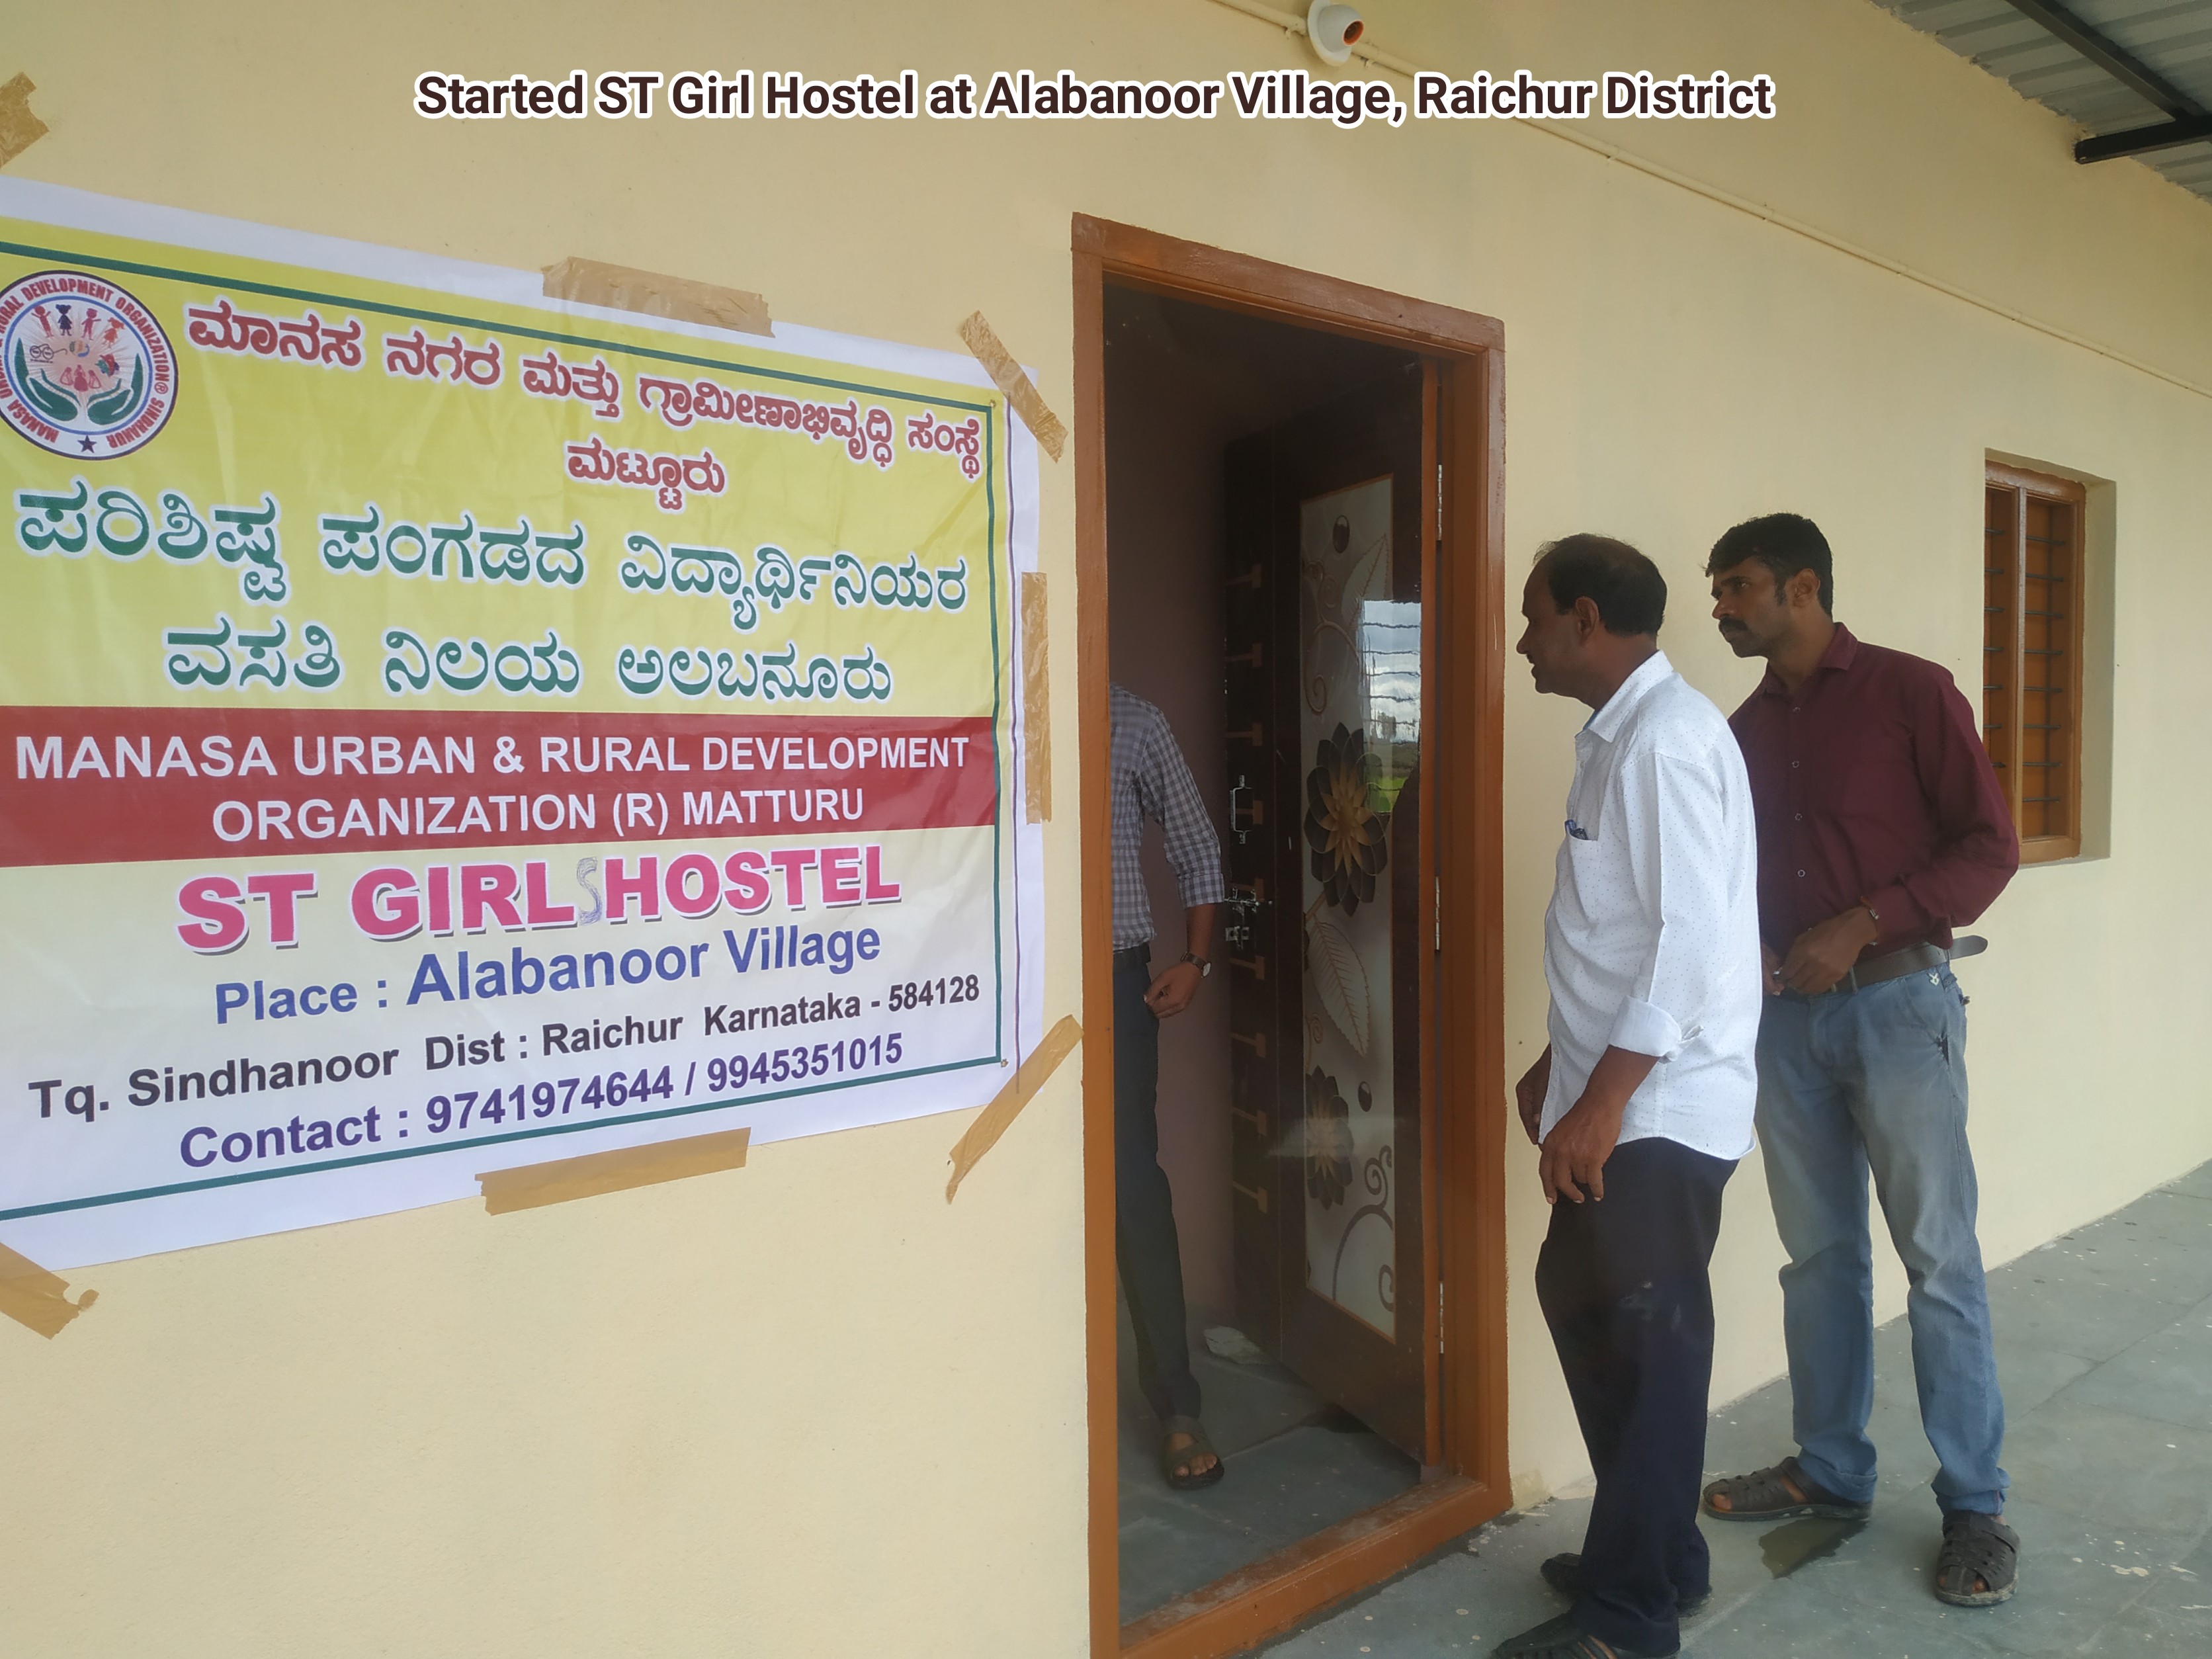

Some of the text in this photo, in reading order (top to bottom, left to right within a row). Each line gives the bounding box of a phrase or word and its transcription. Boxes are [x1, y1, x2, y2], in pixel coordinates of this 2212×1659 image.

[21, 278, 114, 302] DEVELOPMENT
[7, 399, 60, 443] MANASA
[106, 397, 165, 448] SINDHANUR
[188, 300, 361, 366] ಮಾನಸ
[386, 331, 500, 385] ನಗರ
[523, 352, 620, 417] ಮತ್ತು
[908, 413, 980, 478] ಸಂಸ್ಥೆ
[567, 437, 725, 510] ಮಟ್ಟೂರು
[18, 480, 966, 630] ಪರಿಶಿಷ್ಟ ಪಂಗಡದ ವಿದ್ಯಾರ್ಥಿನಿಯರ
[166, 617, 891, 700] ವಸತಿ ನಿಲಯ ಅಲಬನೂರು
[17, 736, 968, 779] MANASA URBAN & RURAL DEVELOPMENT
[213, 788, 862, 842] ORGANIZATION (R) MATTURU
[180, 874, 313, 947] ST
[606, 847, 899, 917] HOSTEL
[216, 981, 357, 1023] Place
[407, 944, 708, 1004] Alabanoor
[724, 925, 879, 974] Village
[29, 1080, 108, 1122] Tq.
[129, 1050, 398, 1106] Sindhanoor
[426, 1032, 505, 1070] Dist
[543, 1016, 683, 1055] Raichur
[705, 993, 860, 1035] Karnataka
[889, 974, 978, 1011] 584128
[181, 1106, 380, 1167] Contact
[427, 1066, 673, 1132] 9741974644
[685, 1062, 695, 1095] /
[708, 1033, 902, 1091] 9945351015
